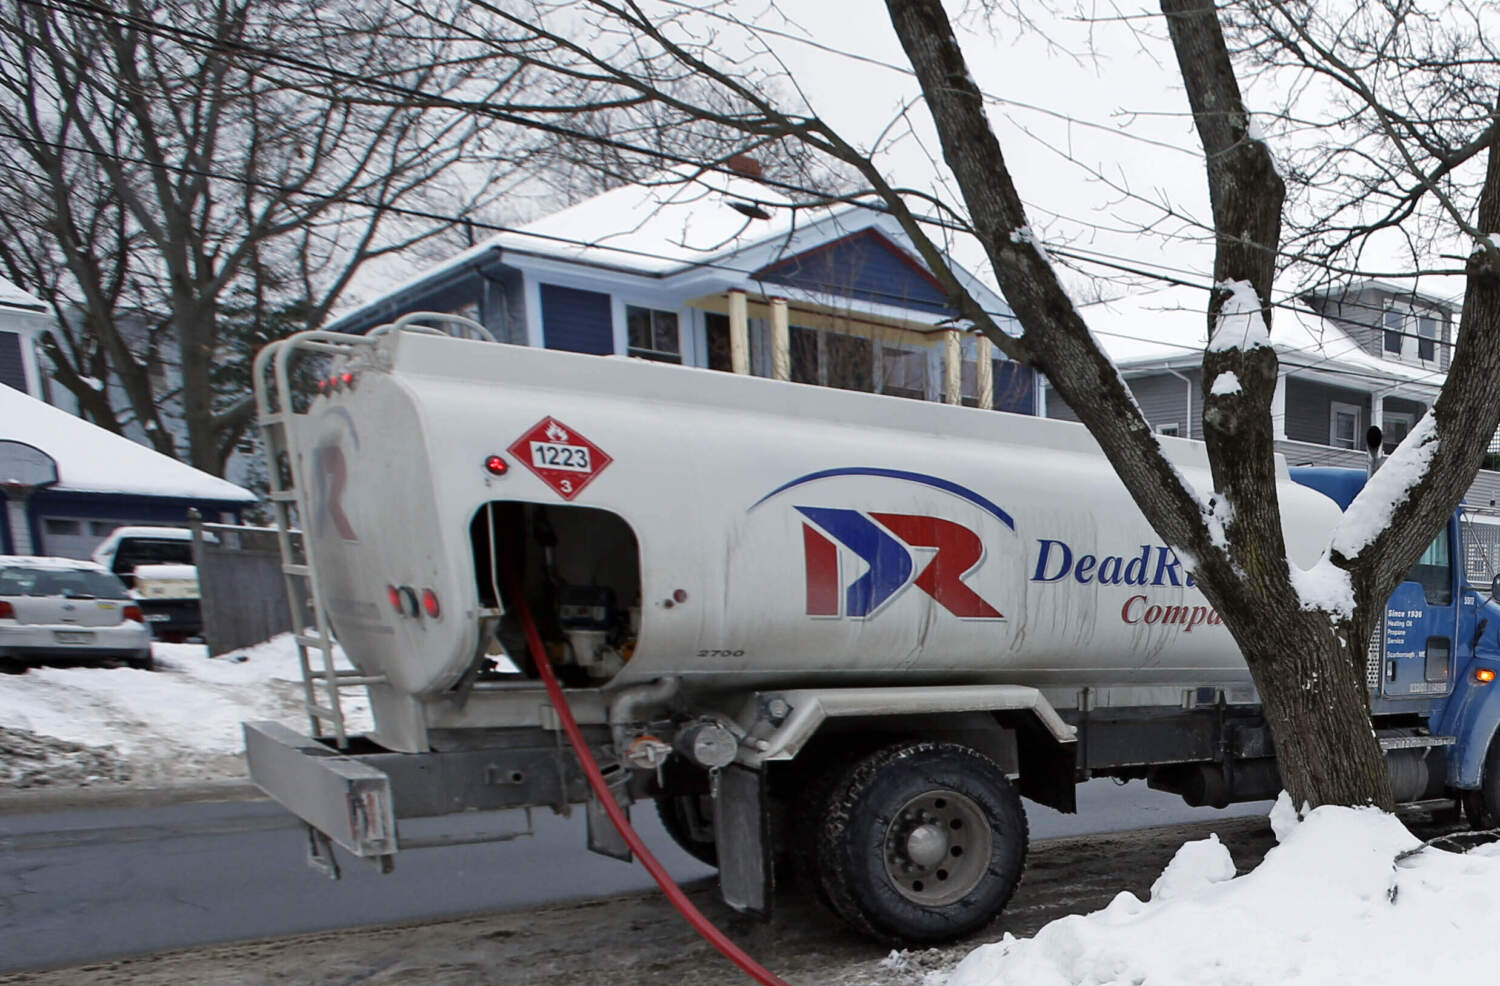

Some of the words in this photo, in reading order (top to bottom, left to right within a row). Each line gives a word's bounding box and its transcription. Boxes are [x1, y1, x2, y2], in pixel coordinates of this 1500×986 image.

[536, 445, 588, 468] 1223
[560, 480, 573, 493] 3
[792, 506, 1005, 619] DR
[1388, 609, 1405, 618] Since
